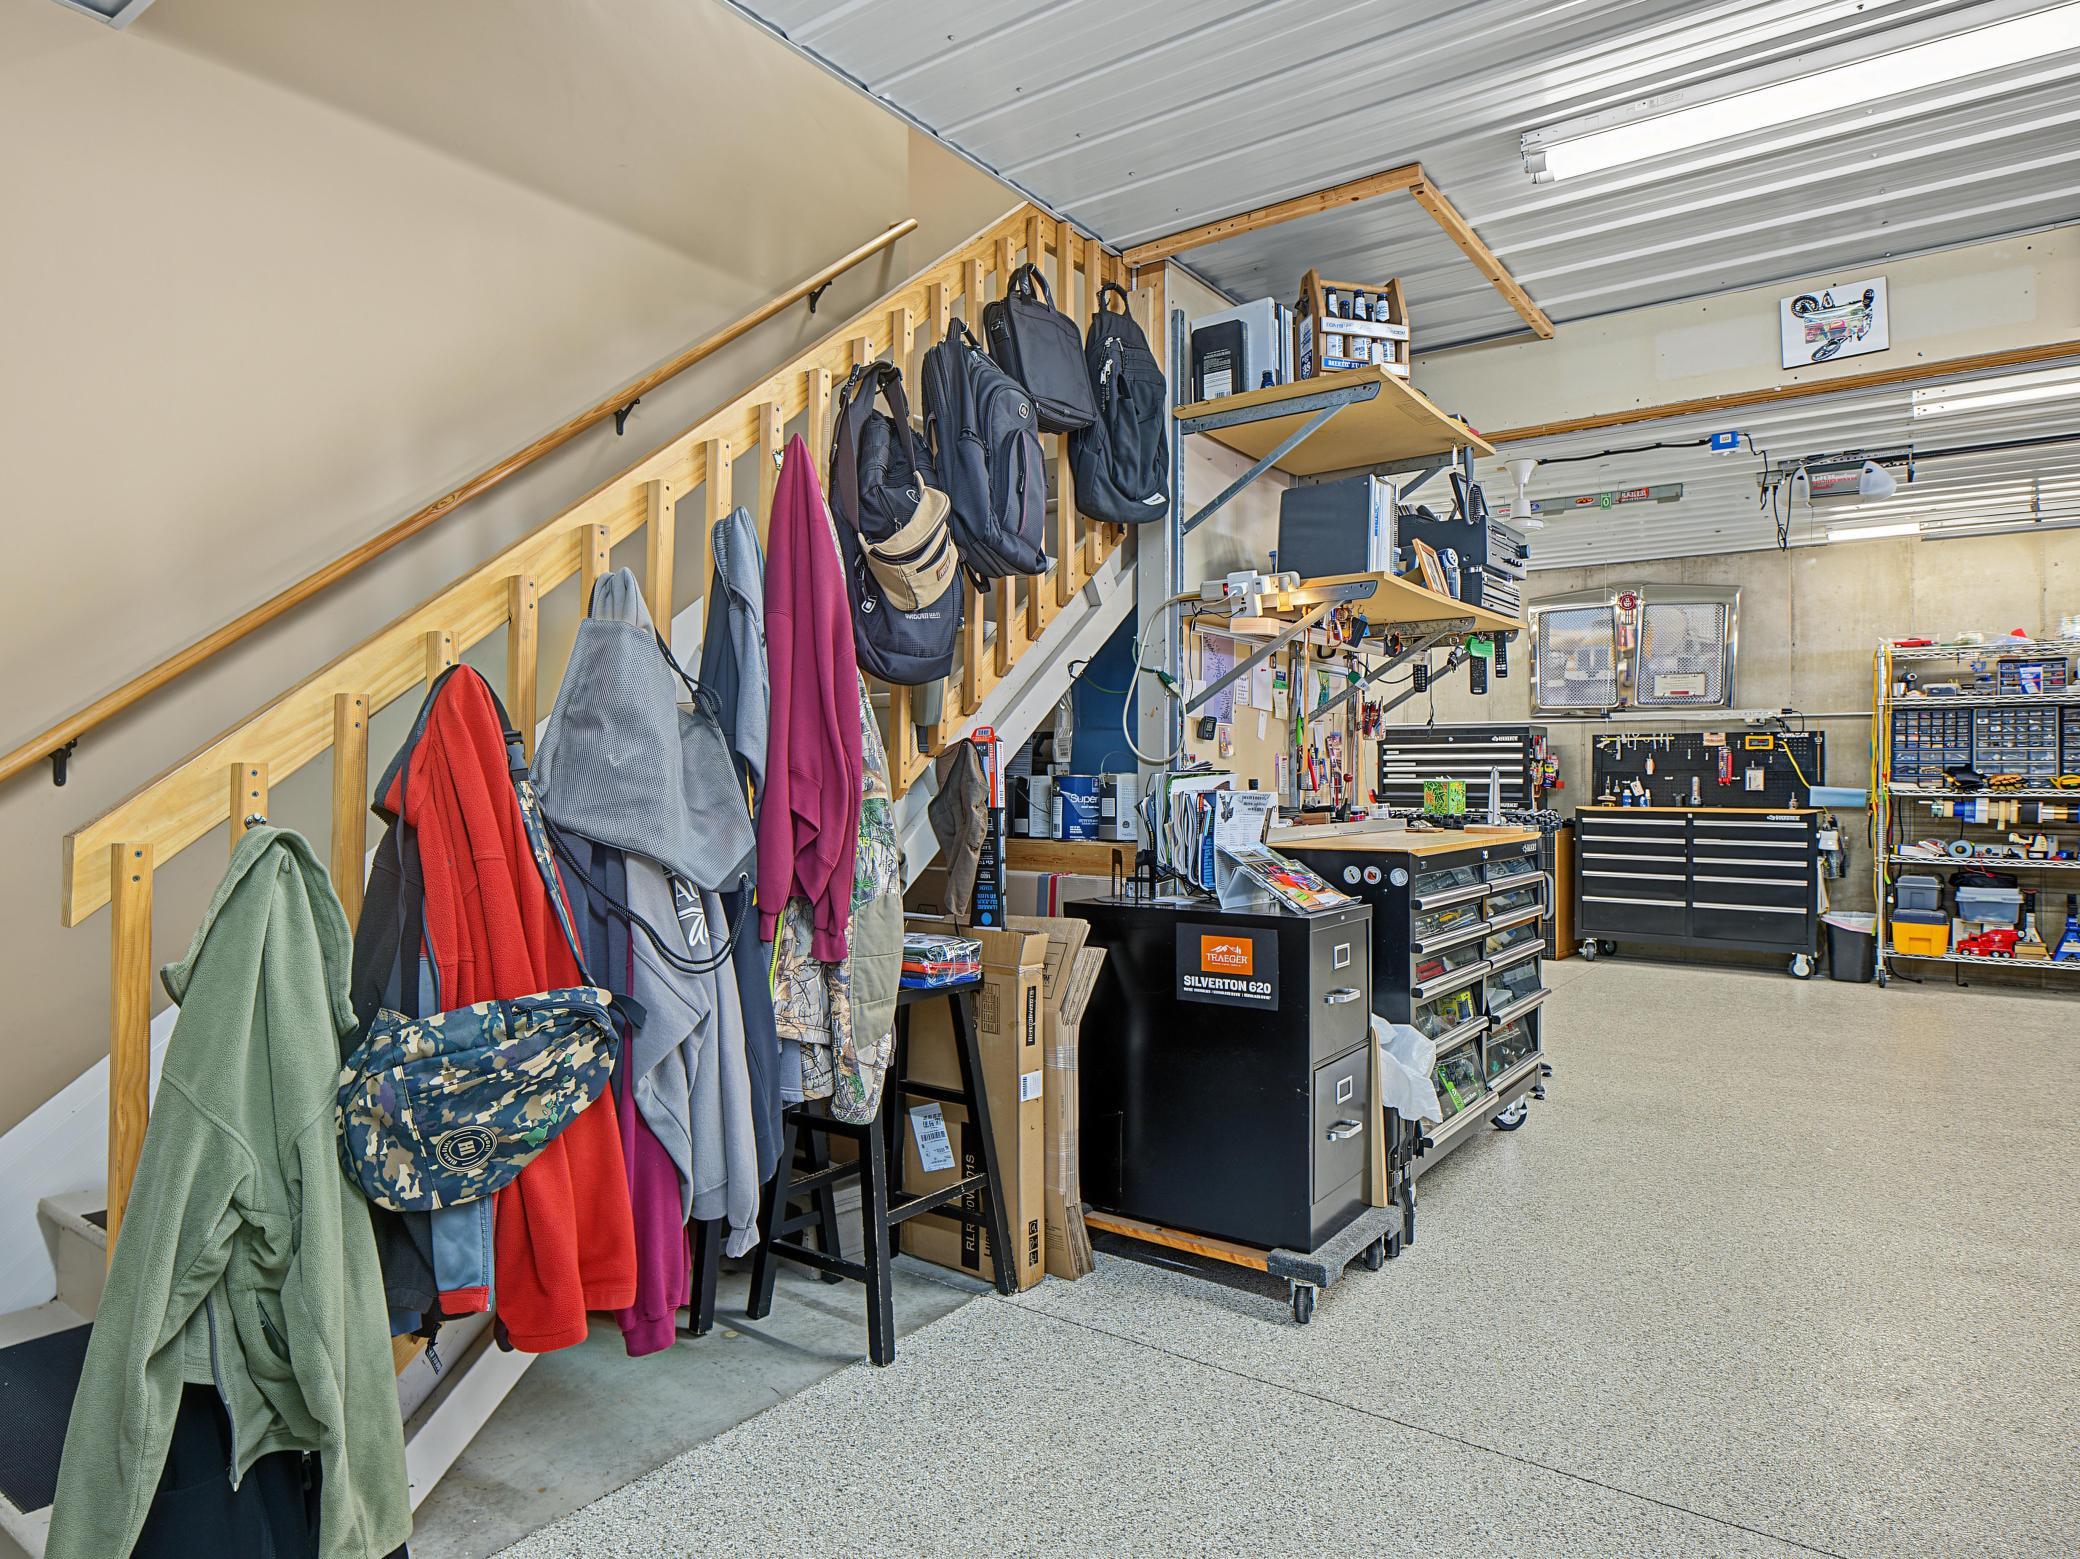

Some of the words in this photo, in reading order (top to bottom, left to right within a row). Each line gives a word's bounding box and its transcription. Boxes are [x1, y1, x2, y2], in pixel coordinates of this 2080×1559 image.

[1206, 952, 1248, 964] TRAEGER
[1183, 975, 1247, 992] SILVERTON
[1248, 981, 1272, 994] 620
